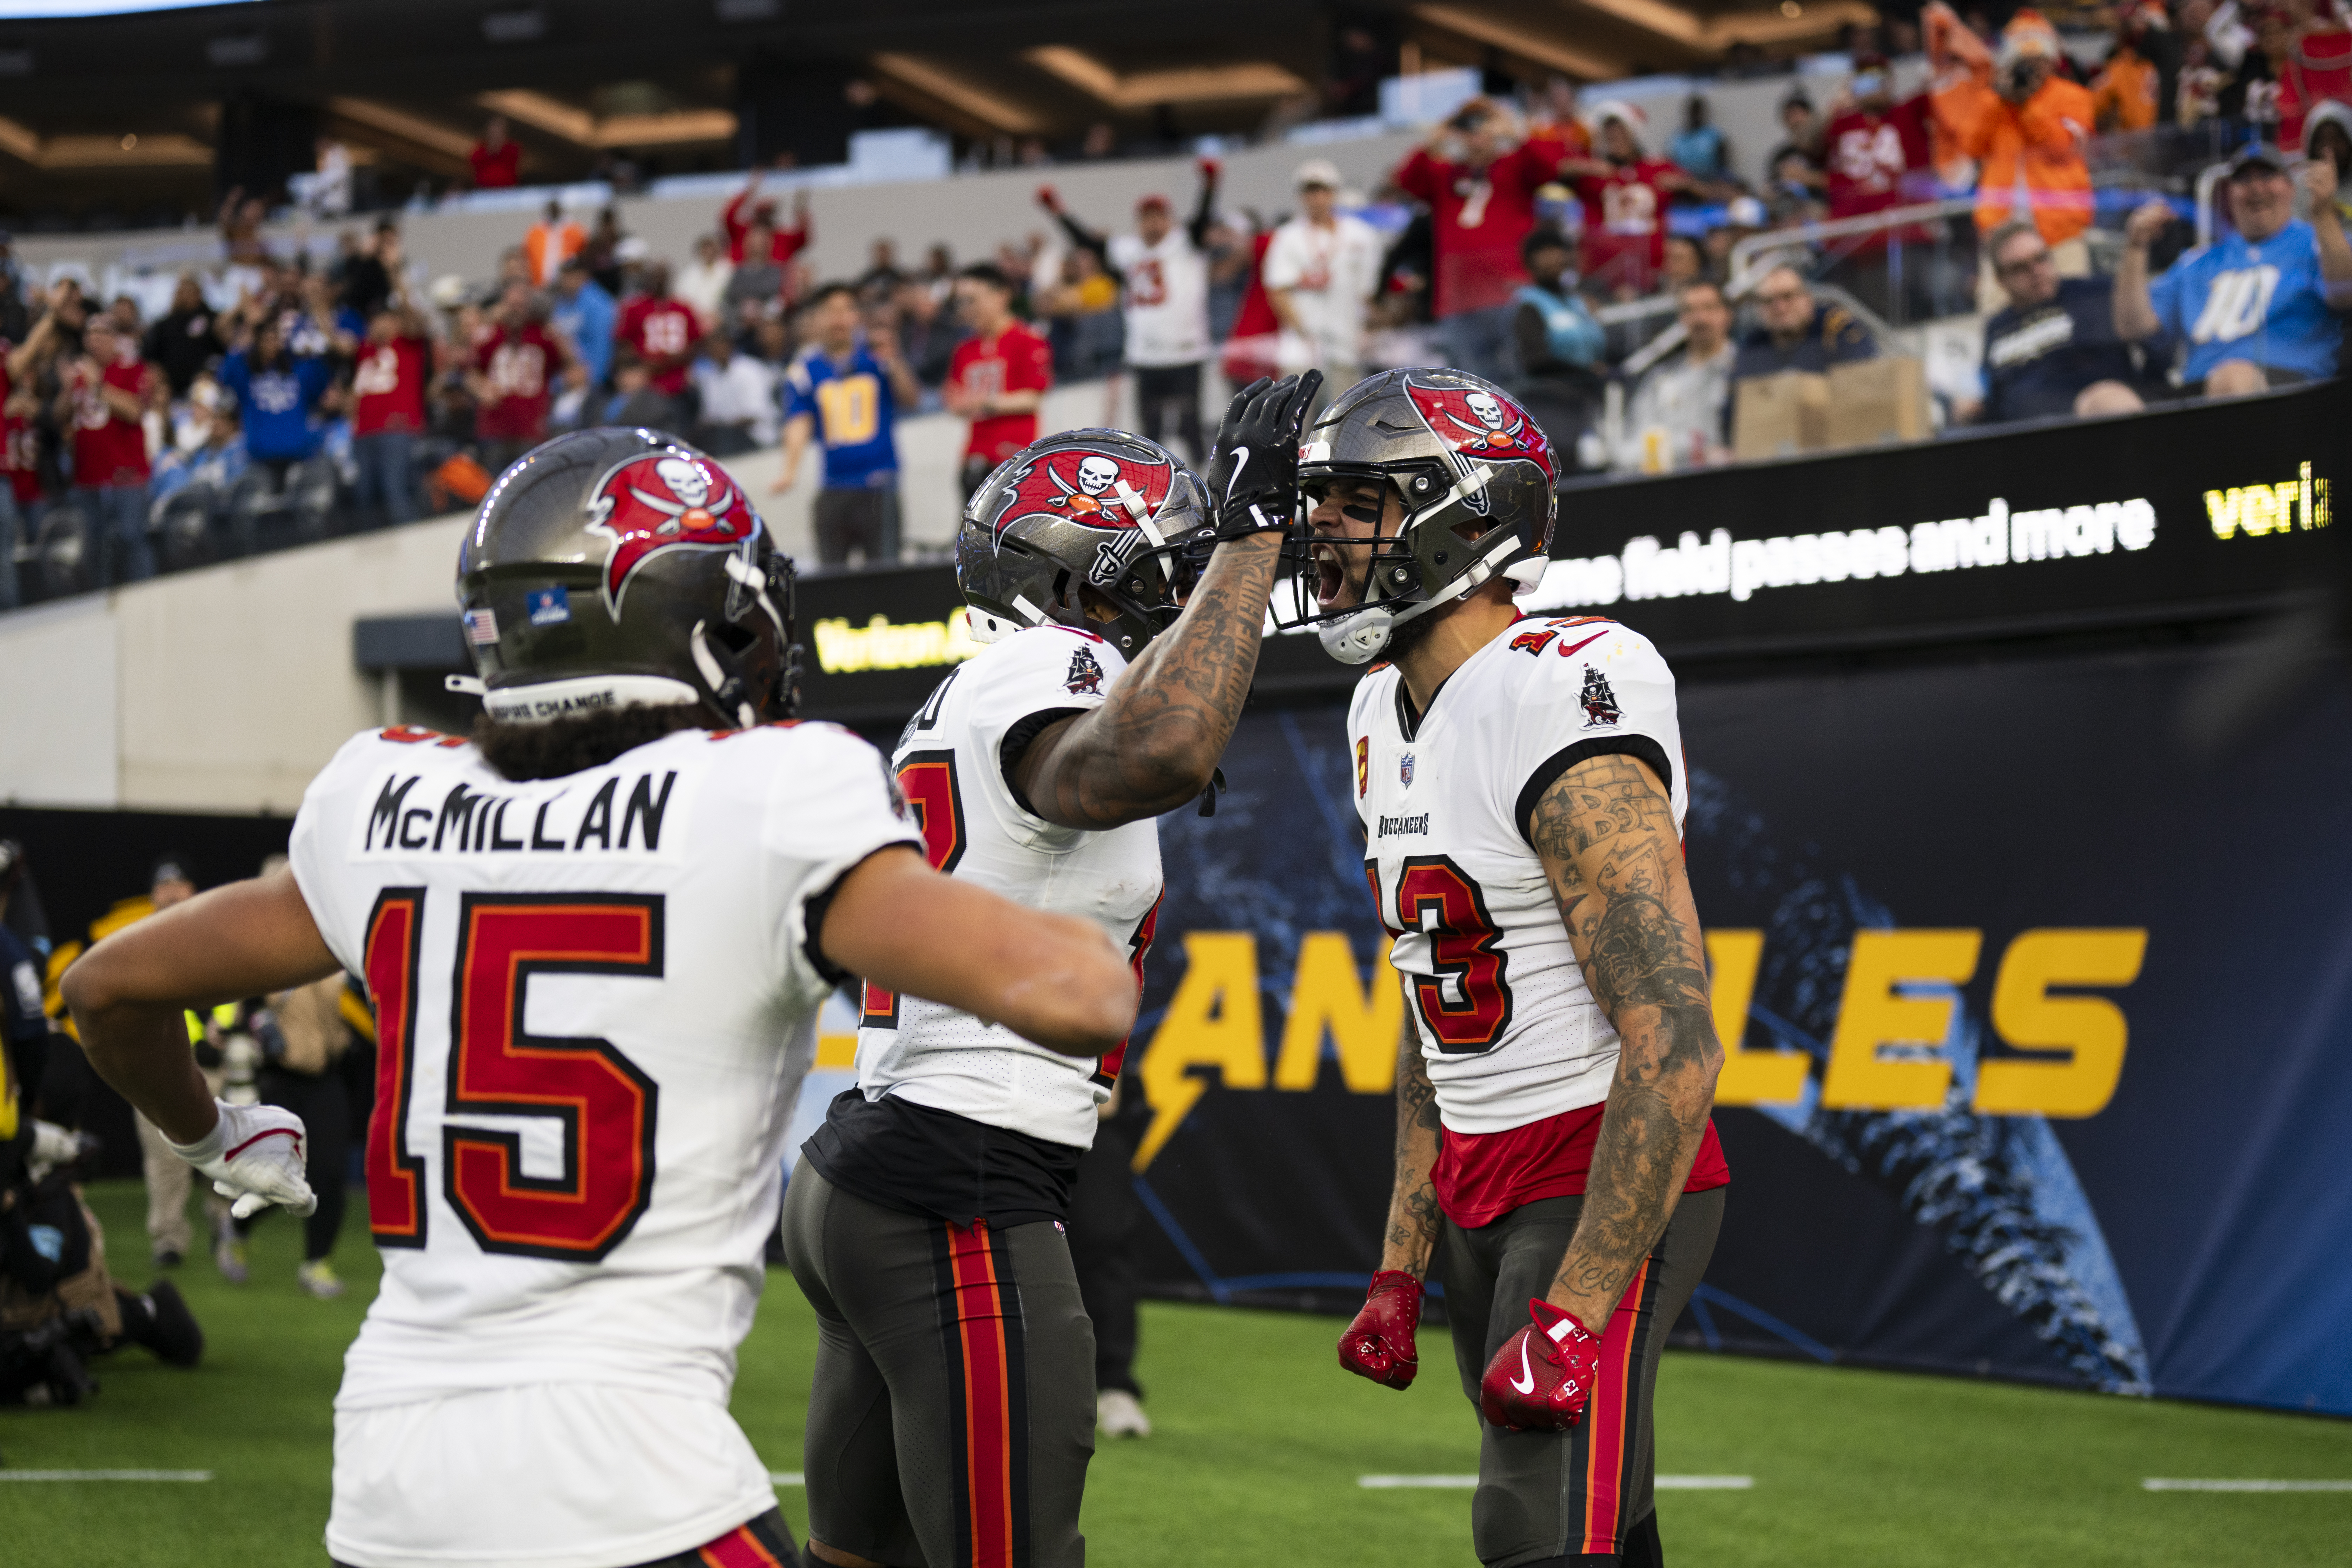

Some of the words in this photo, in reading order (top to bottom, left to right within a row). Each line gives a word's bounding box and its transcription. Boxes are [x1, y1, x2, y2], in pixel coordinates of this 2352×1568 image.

[819, 373, 880, 445] 10
[1909, 497, 2009, 574] and
[2010, 498, 2157, 563] more
[1378, 812, 1429, 840] BUCCANEERS
[364, 886, 665, 1264] 15
[1131, 928, 2148, 1173] ANLES
